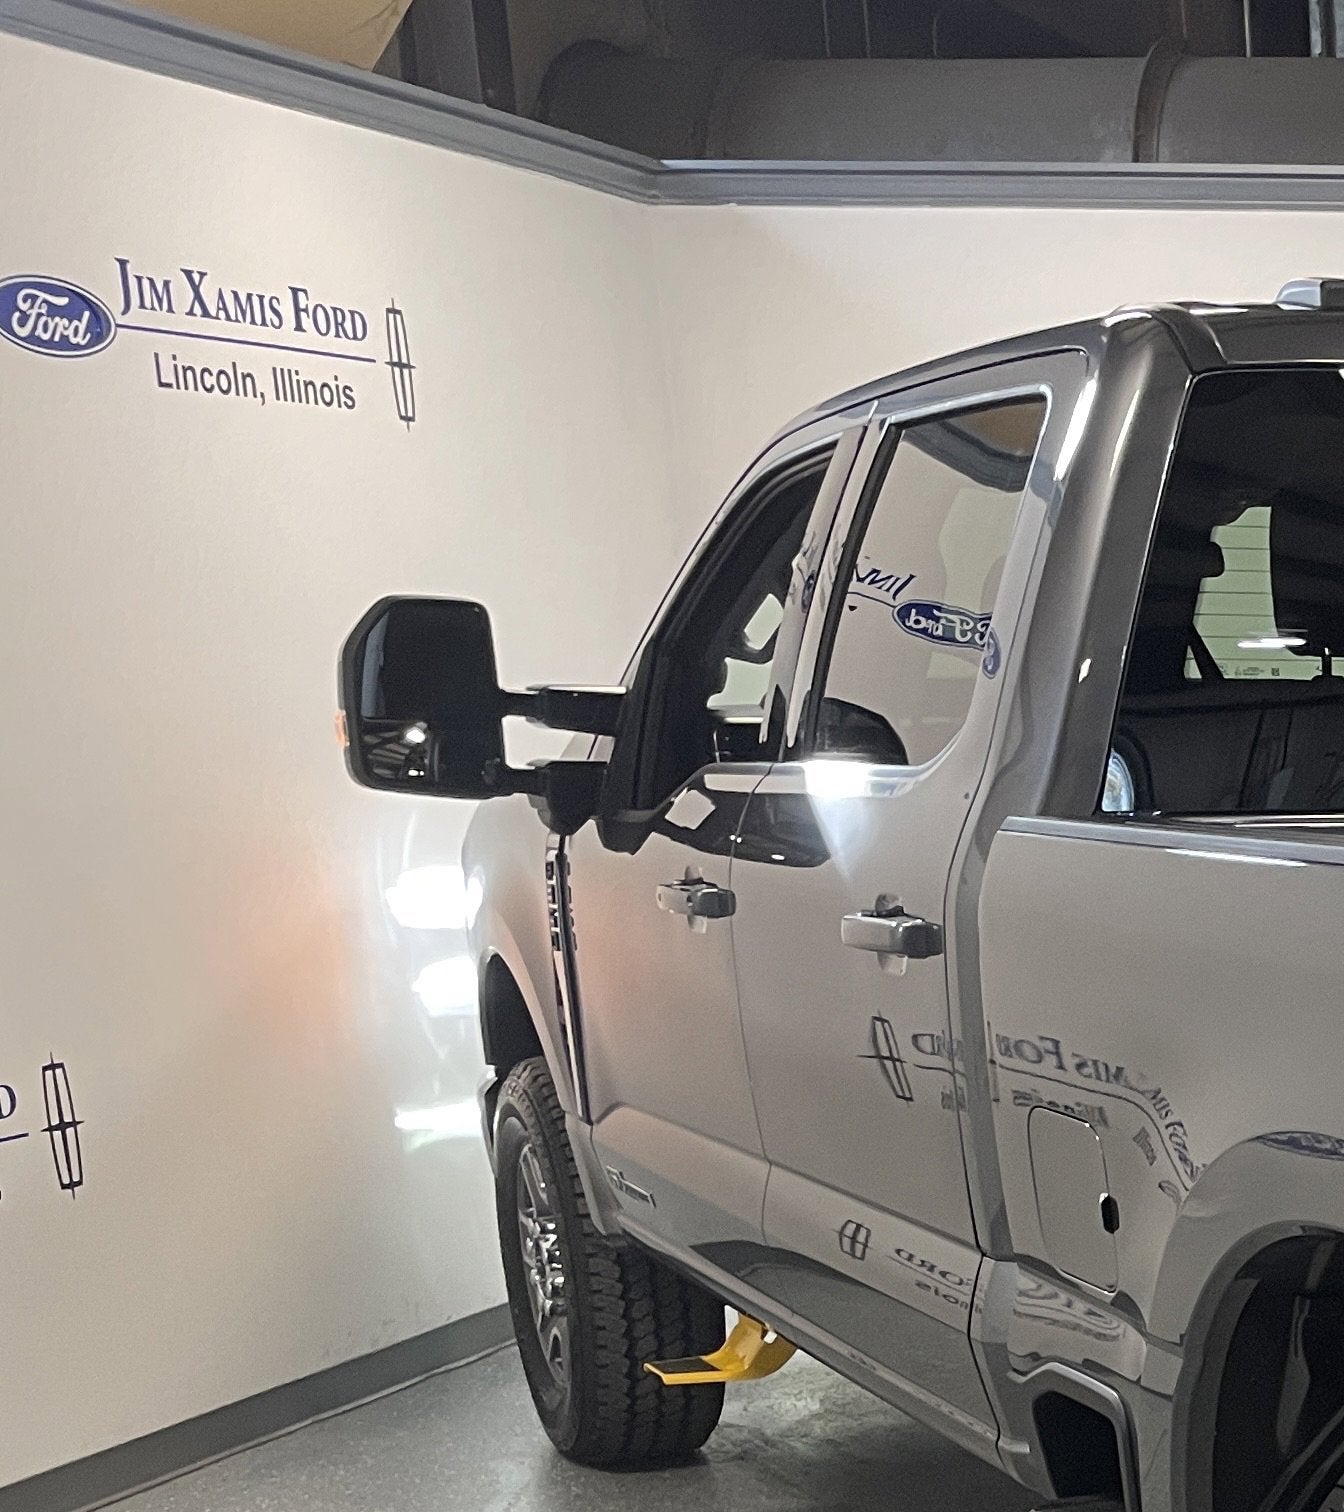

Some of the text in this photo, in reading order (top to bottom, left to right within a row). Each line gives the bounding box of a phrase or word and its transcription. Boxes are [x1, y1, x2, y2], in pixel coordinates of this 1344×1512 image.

[11, 287, 91, 347] Ford
[154, 352, 357, 410] Lincoln, Illinois
